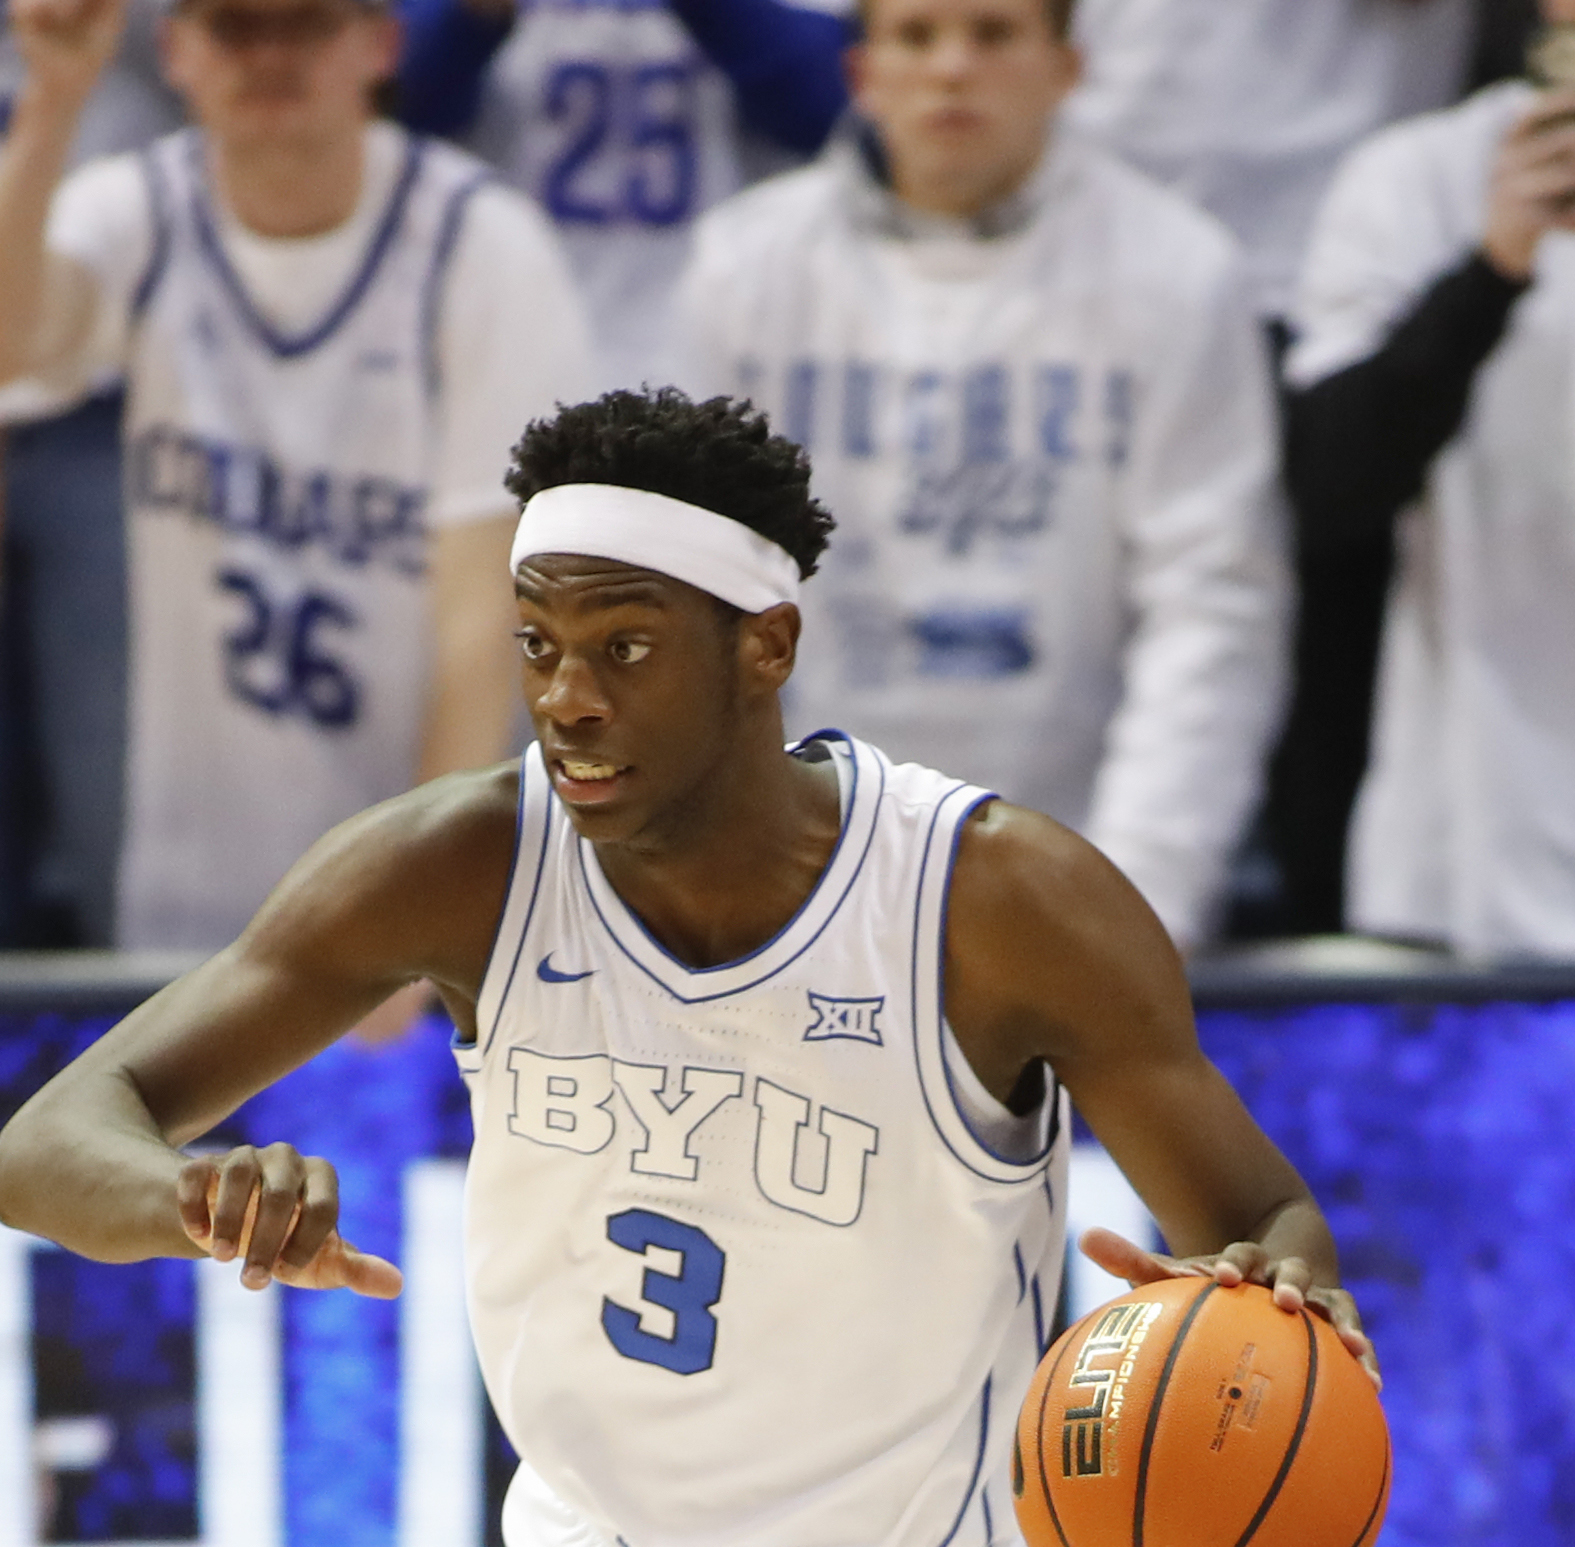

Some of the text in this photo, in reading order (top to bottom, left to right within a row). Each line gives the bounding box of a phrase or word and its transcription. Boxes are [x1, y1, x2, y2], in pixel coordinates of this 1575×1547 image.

[542, 60, 700, 228] 25
[506, 1046, 880, 1228] BYU
[600, 1207, 727, 1377] 3
[1061, 1301, 1153, 1479] ELITE
